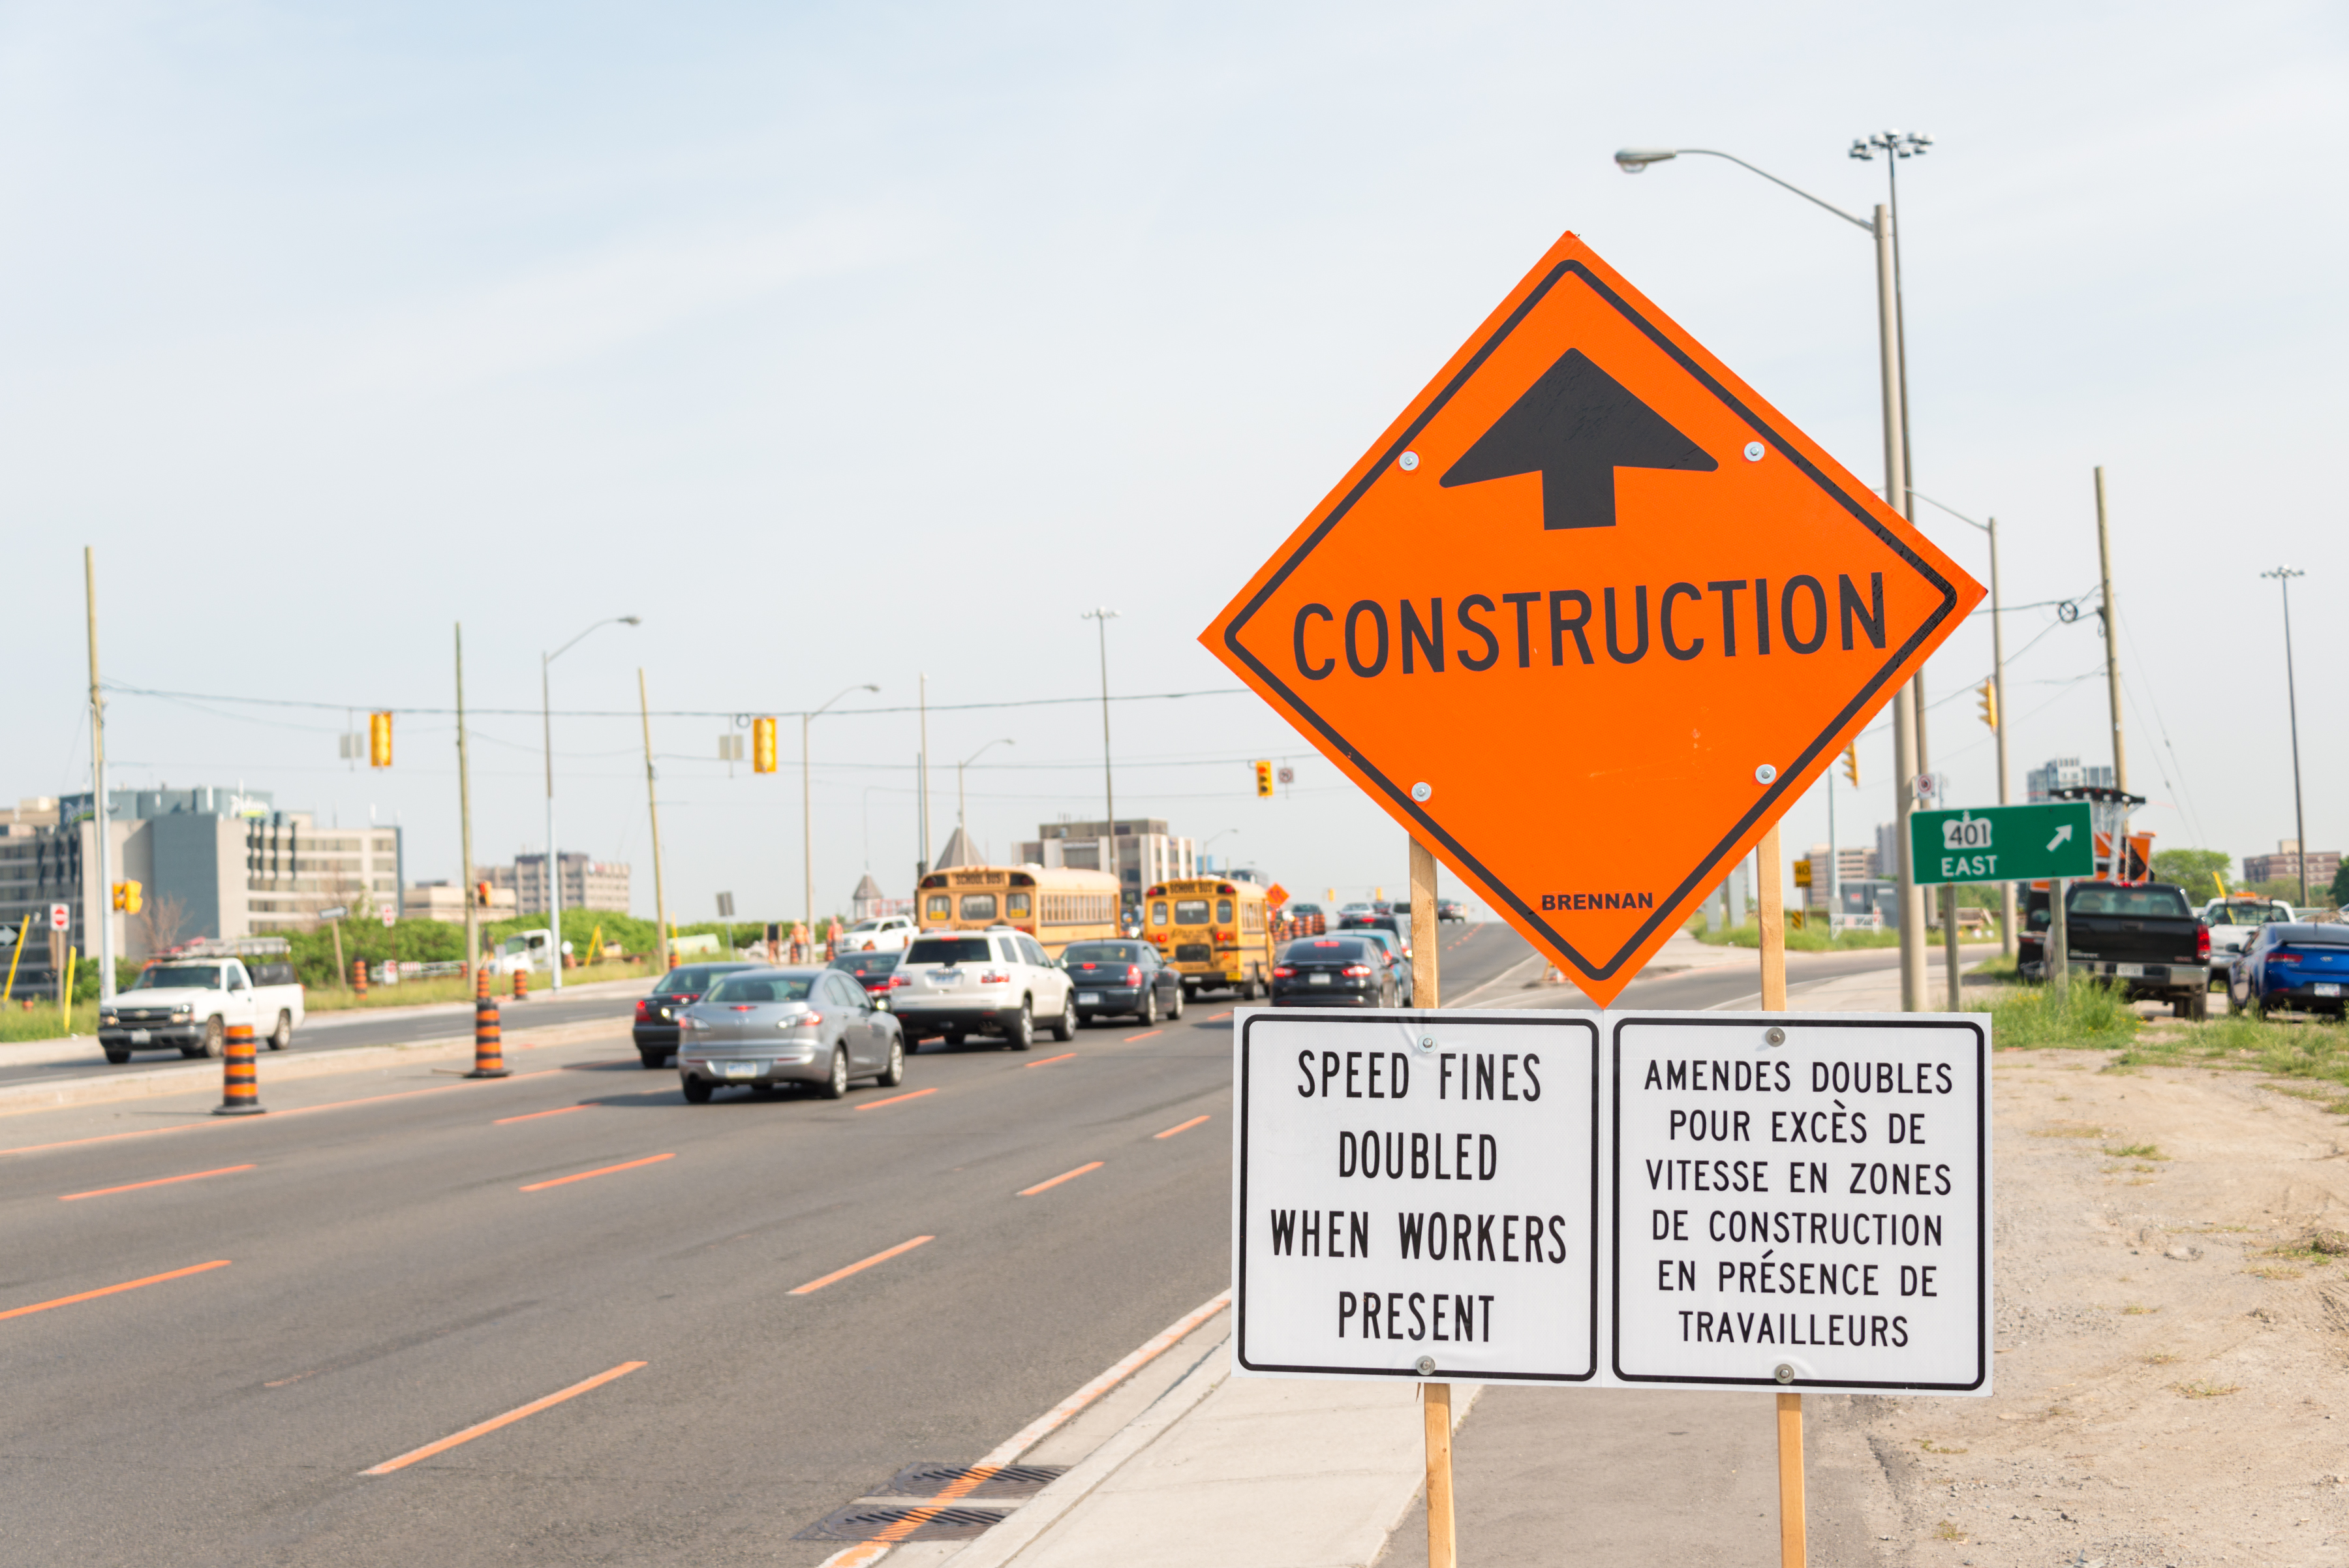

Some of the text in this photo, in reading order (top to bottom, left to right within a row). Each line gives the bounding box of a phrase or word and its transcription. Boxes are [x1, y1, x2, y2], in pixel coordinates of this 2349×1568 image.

[1293, 572, 1886, 681] CONSTRUCTION
[1948, 823, 1988, 846] 401
[955, 872, 1001, 885] SCHOOL BUS
[1795, 865, 1810, 876] 40
[1941, 854, 1998, 877] EAST
[1169, 882, 1212, 894] SCHOOL BUS
[1542, 892, 1653, 911] BRENNAN
[1298, 1050, 1541, 1102] SPEED FINES
[1644, 1060, 1952, 1094] AMENDES DOUBLES
[1670, 1099, 1926, 1145] POUR EXCÈS DE
[1340, 1130, 1497, 1180] DOUBLED
[1646, 1159, 1951, 1195] VITESSE EN ZONES
[1270, 1209, 1566, 1264] WHEN WORKERS
[1653, 1210, 1941, 1246] DE CONSTRUCTION
[1659, 1249, 1937, 1297] EN PRÉSENCE DE
[1339, 1291, 1494, 1342] PRESENT
[1678, 1311, 1908, 1347] TRAVAILLEURS
